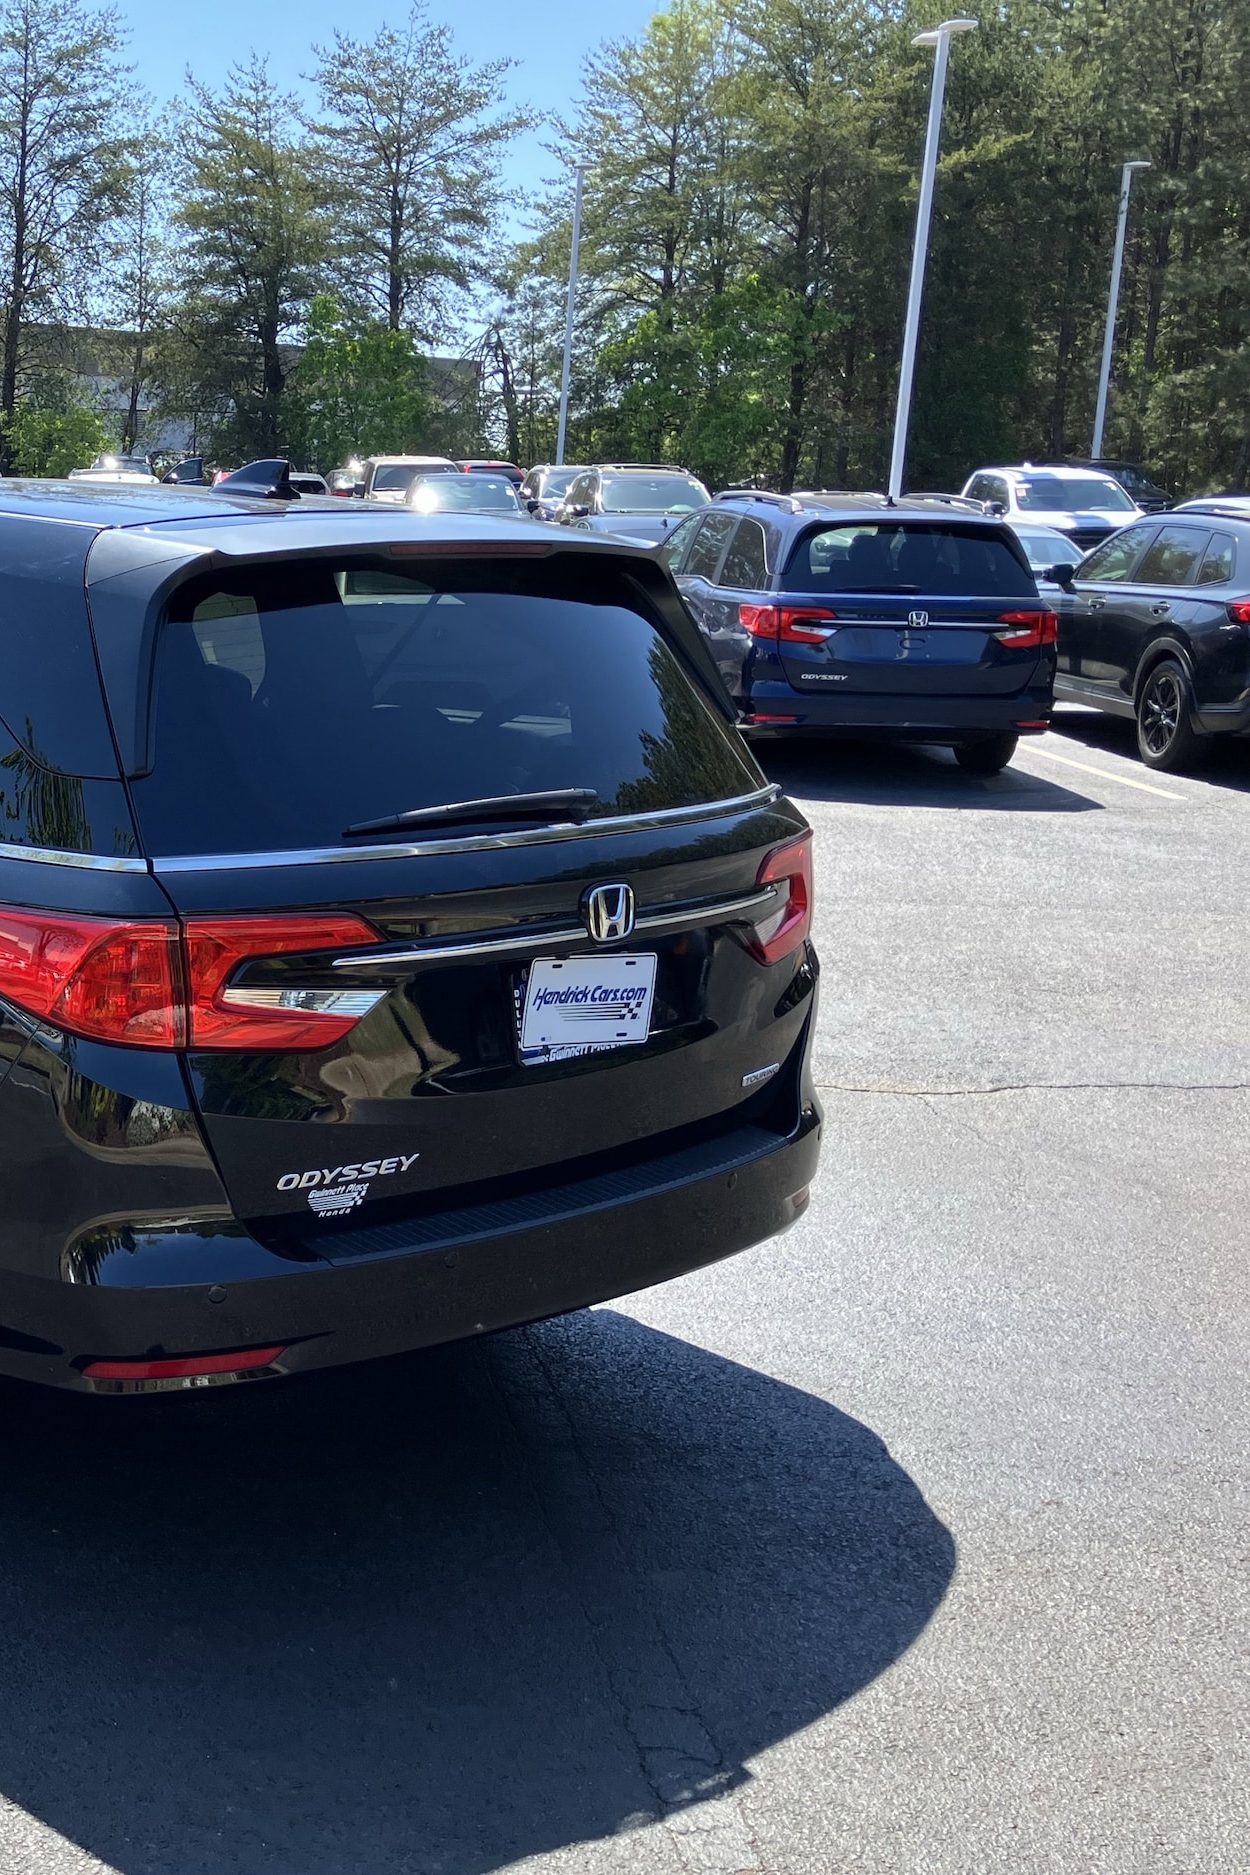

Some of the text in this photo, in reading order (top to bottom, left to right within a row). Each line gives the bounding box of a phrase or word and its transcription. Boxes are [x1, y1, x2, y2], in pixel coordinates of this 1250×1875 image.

[276, 1153, 420, 1191] ODYSSEY
[308, 1185, 346, 1199] Gwinnett
[318, 1207, 351, 1218] Honda
